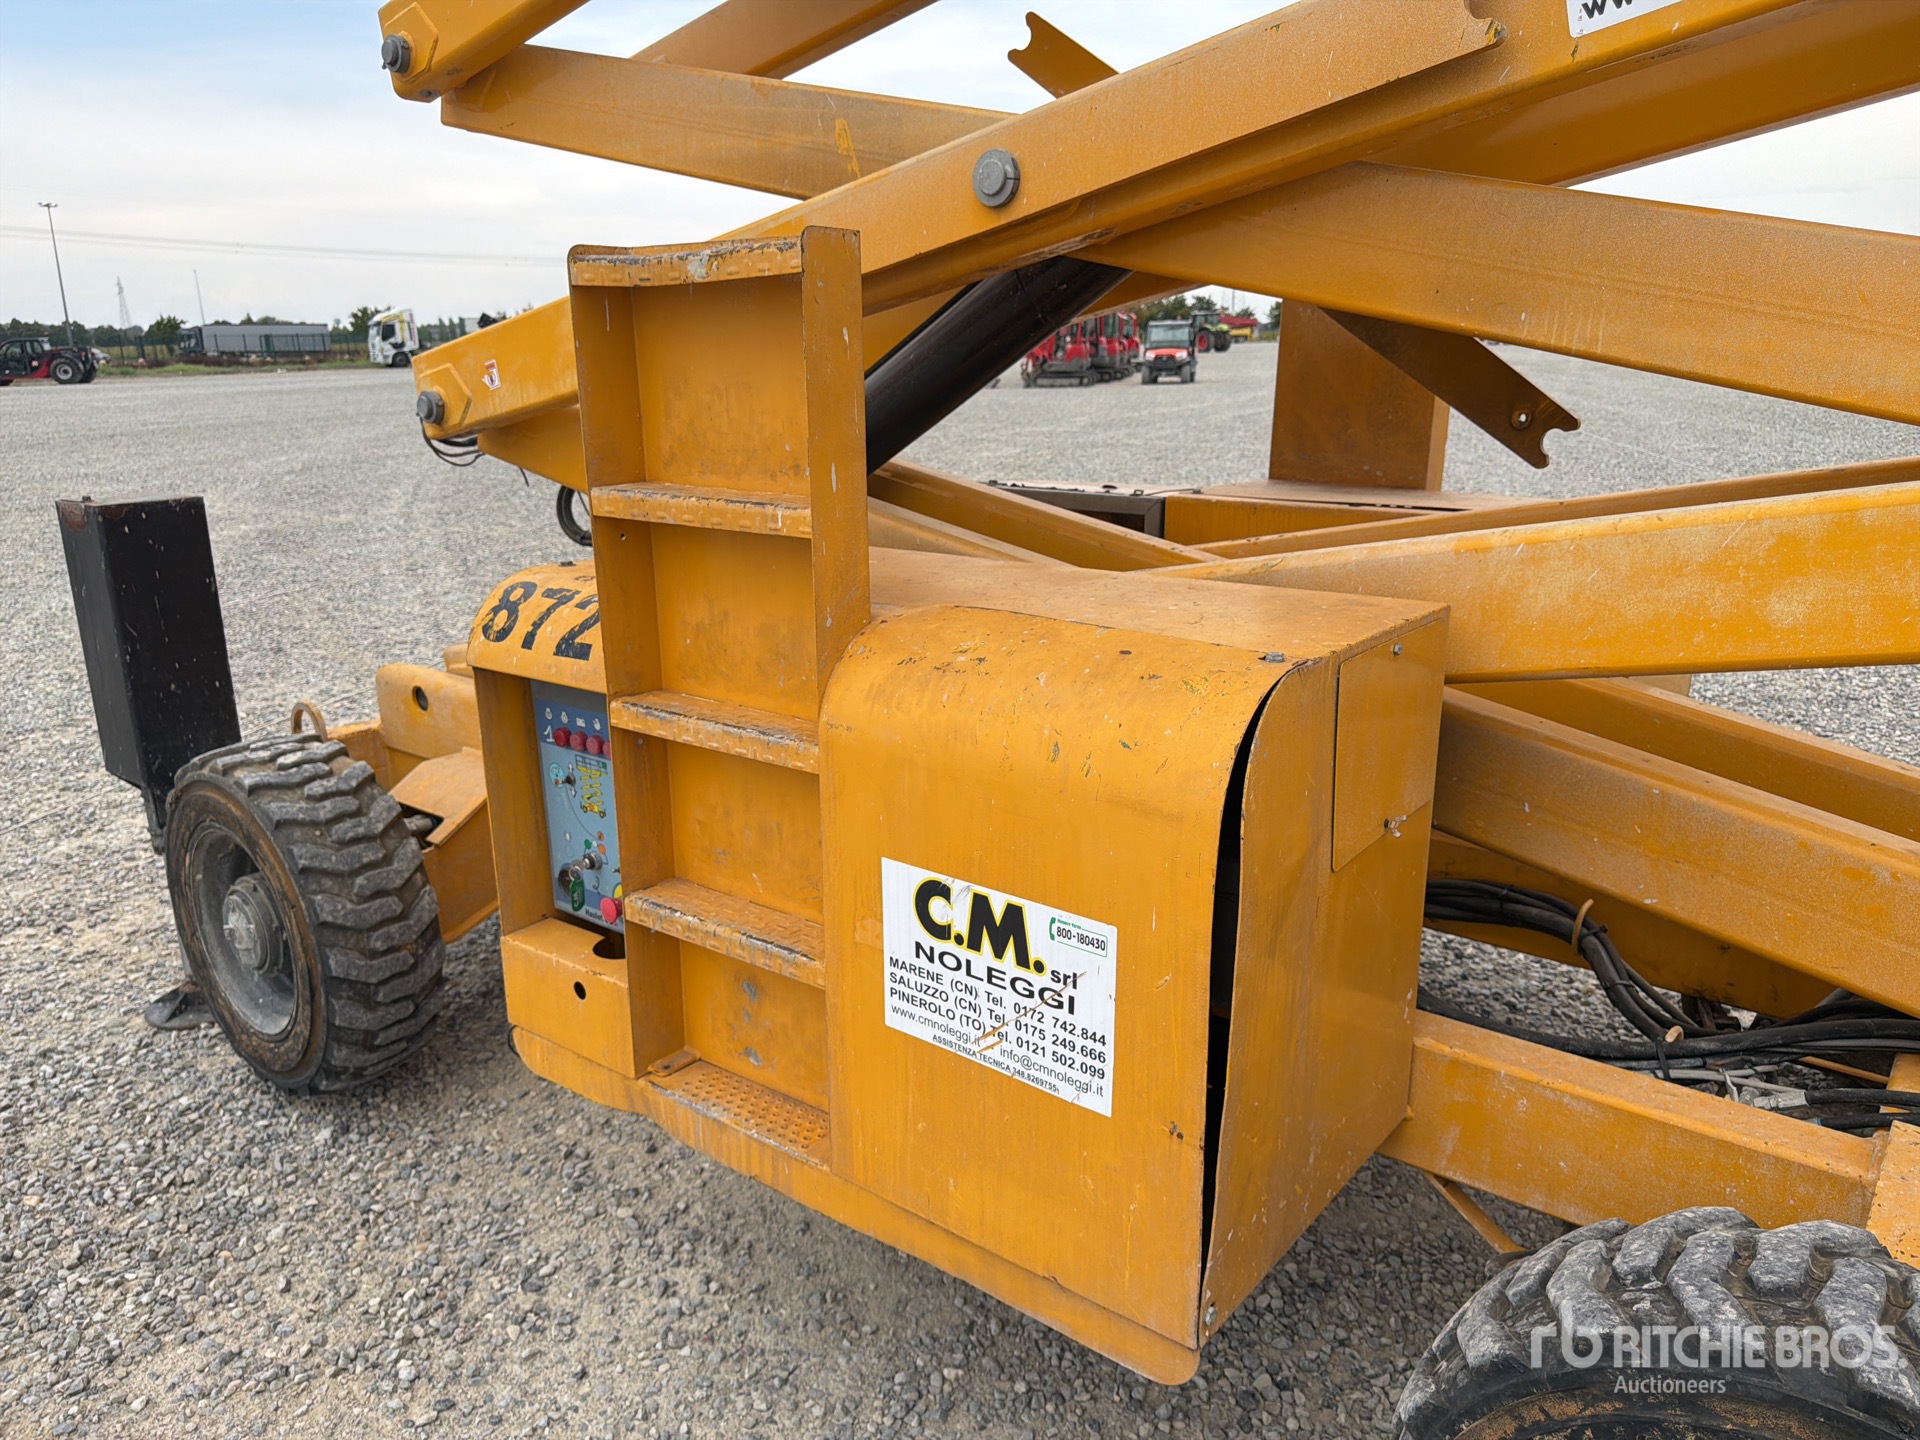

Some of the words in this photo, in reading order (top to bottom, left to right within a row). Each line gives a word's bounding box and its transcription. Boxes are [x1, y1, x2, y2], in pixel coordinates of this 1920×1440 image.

[481, 580, 600, 661] 872
[913, 877, 1046, 976] C.M.
[1050, 969, 1078, 990] srl
[914, 940, 1075, 1015] NOLEGGI
[1056, 926, 1106, 951] 800-180430
[889, 956, 944, 985] MARENE
[950, 978, 978, 1000] (CN)
[984, 990, 1007, 1009] Tel.
[1013, 1002, 1045, 1024] 0172
[1052, 1016, 1107, 1047] 742.844
[889, 971, 949, 1003] SALUZZO
[954, 995, 982, 1018] (CN)
[986, 1007, 1009, 1027] Tel.
[1014, 1019, 1046, 1041] 0175
[1051, 1033, 1107, 1064] 249.666
[889, 986, 956, 1021] PINEROLO
[959, 1013, 986, 1036] (TO)
[989, 1024, 1012, 1044] Tel.
[1016, 1036, 1046, 1058] 0121
[1051, 1050, 1106, 1080] 502.099
[890, 1004, 981, 1048] www.cmnoleggi.it
[1000, 1045, 1104, 1097] info@cmnoleggi.it
[932, 1034, 977, 1058] ASSISTENZA
[979, 1052, 1011, 1073] TECNICA
